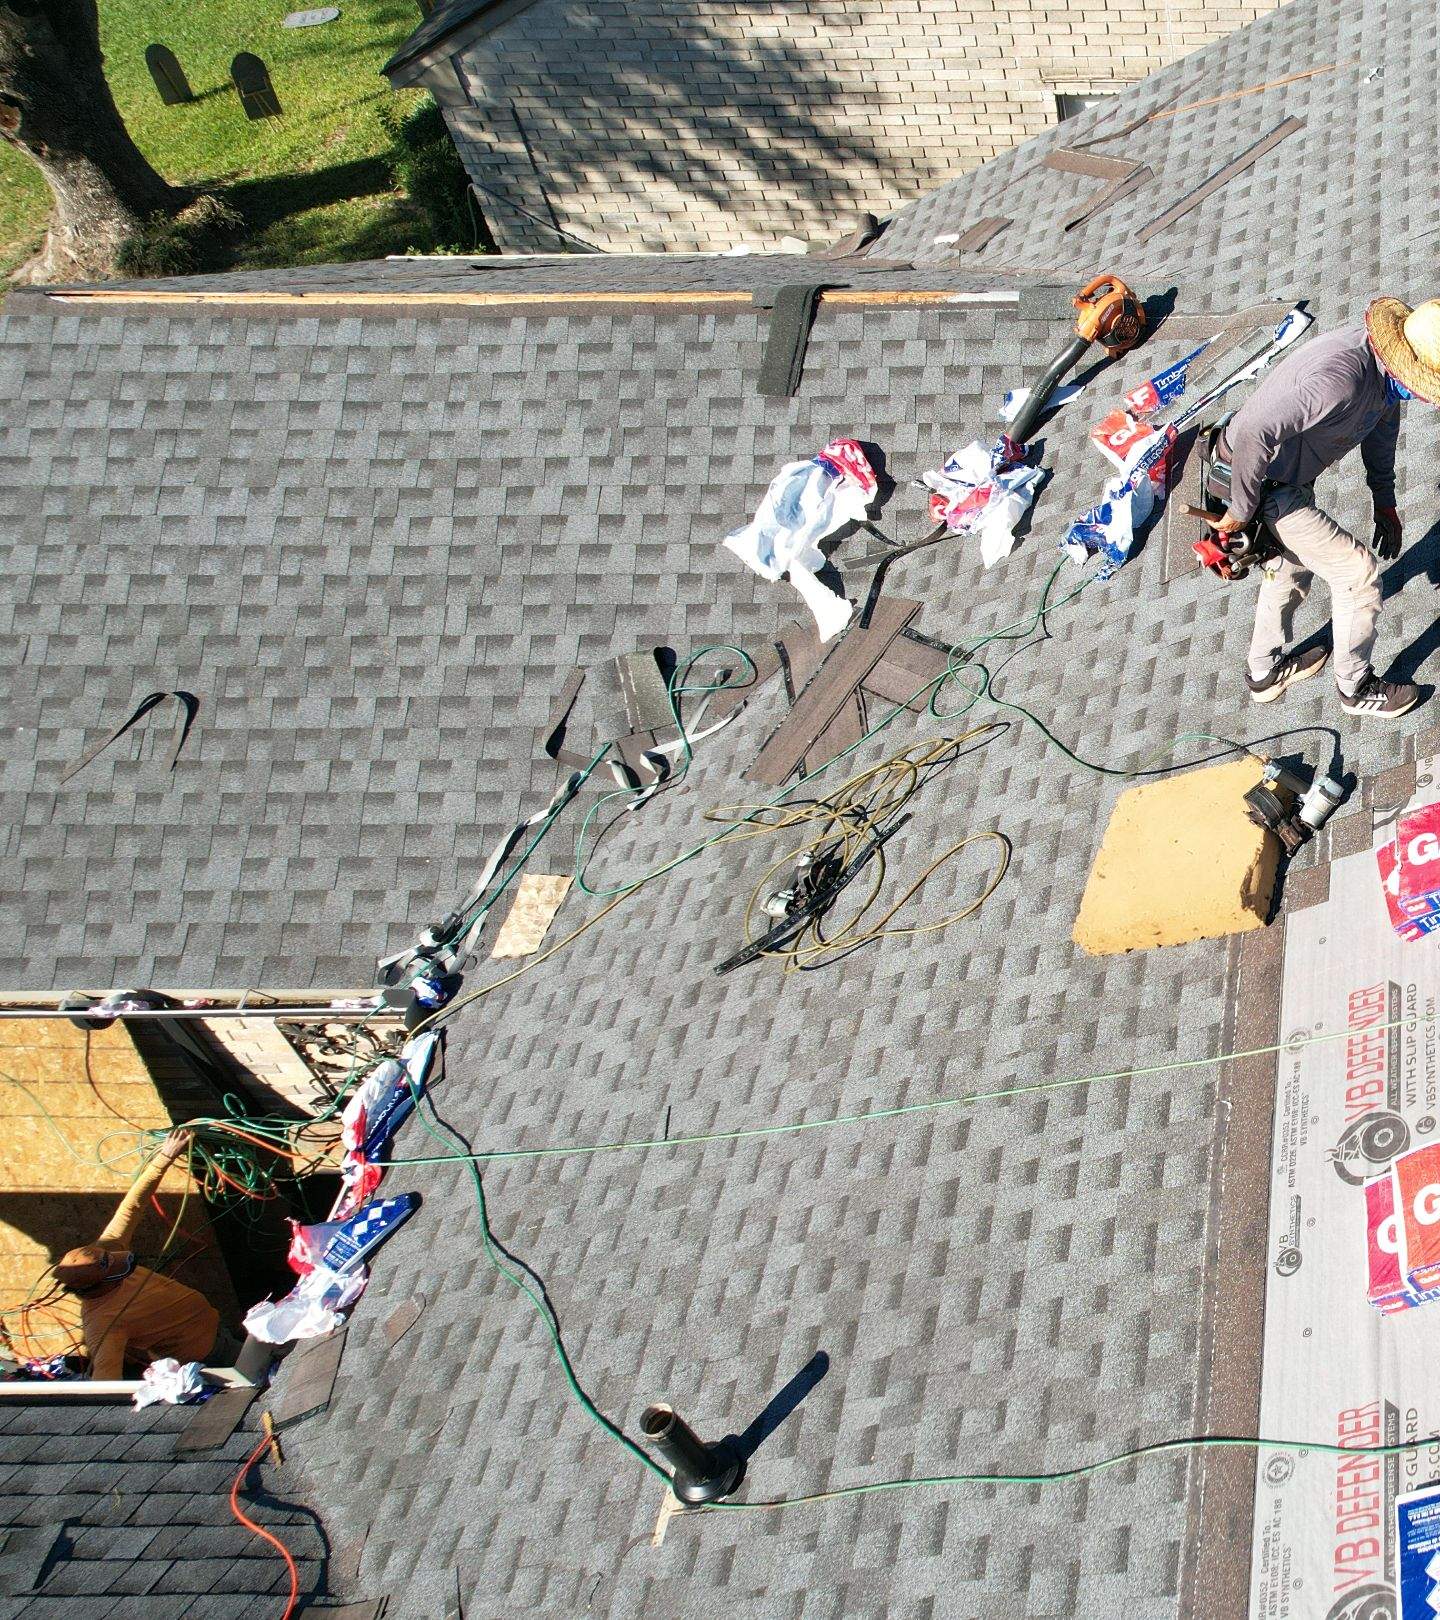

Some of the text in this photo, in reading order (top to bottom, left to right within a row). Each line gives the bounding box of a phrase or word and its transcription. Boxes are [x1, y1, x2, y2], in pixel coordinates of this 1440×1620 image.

[1344, 982, 1385, 1122] VB DEFENDER
[1406, 982, 1416, 1107] WITH SLIP GUARD
[1406, 1407, 1418, 1476] GUARD
[1333, 1400, 1380, 1593] VB DEFENDER
[1387, 1455, 1395, 1501] DEFENSE
[1387, 1502, 1395, 1555] WEATHER
[1268, 1590, 1277, 1616] ASTM
[1279, 1606, 1288, 1618] VB
